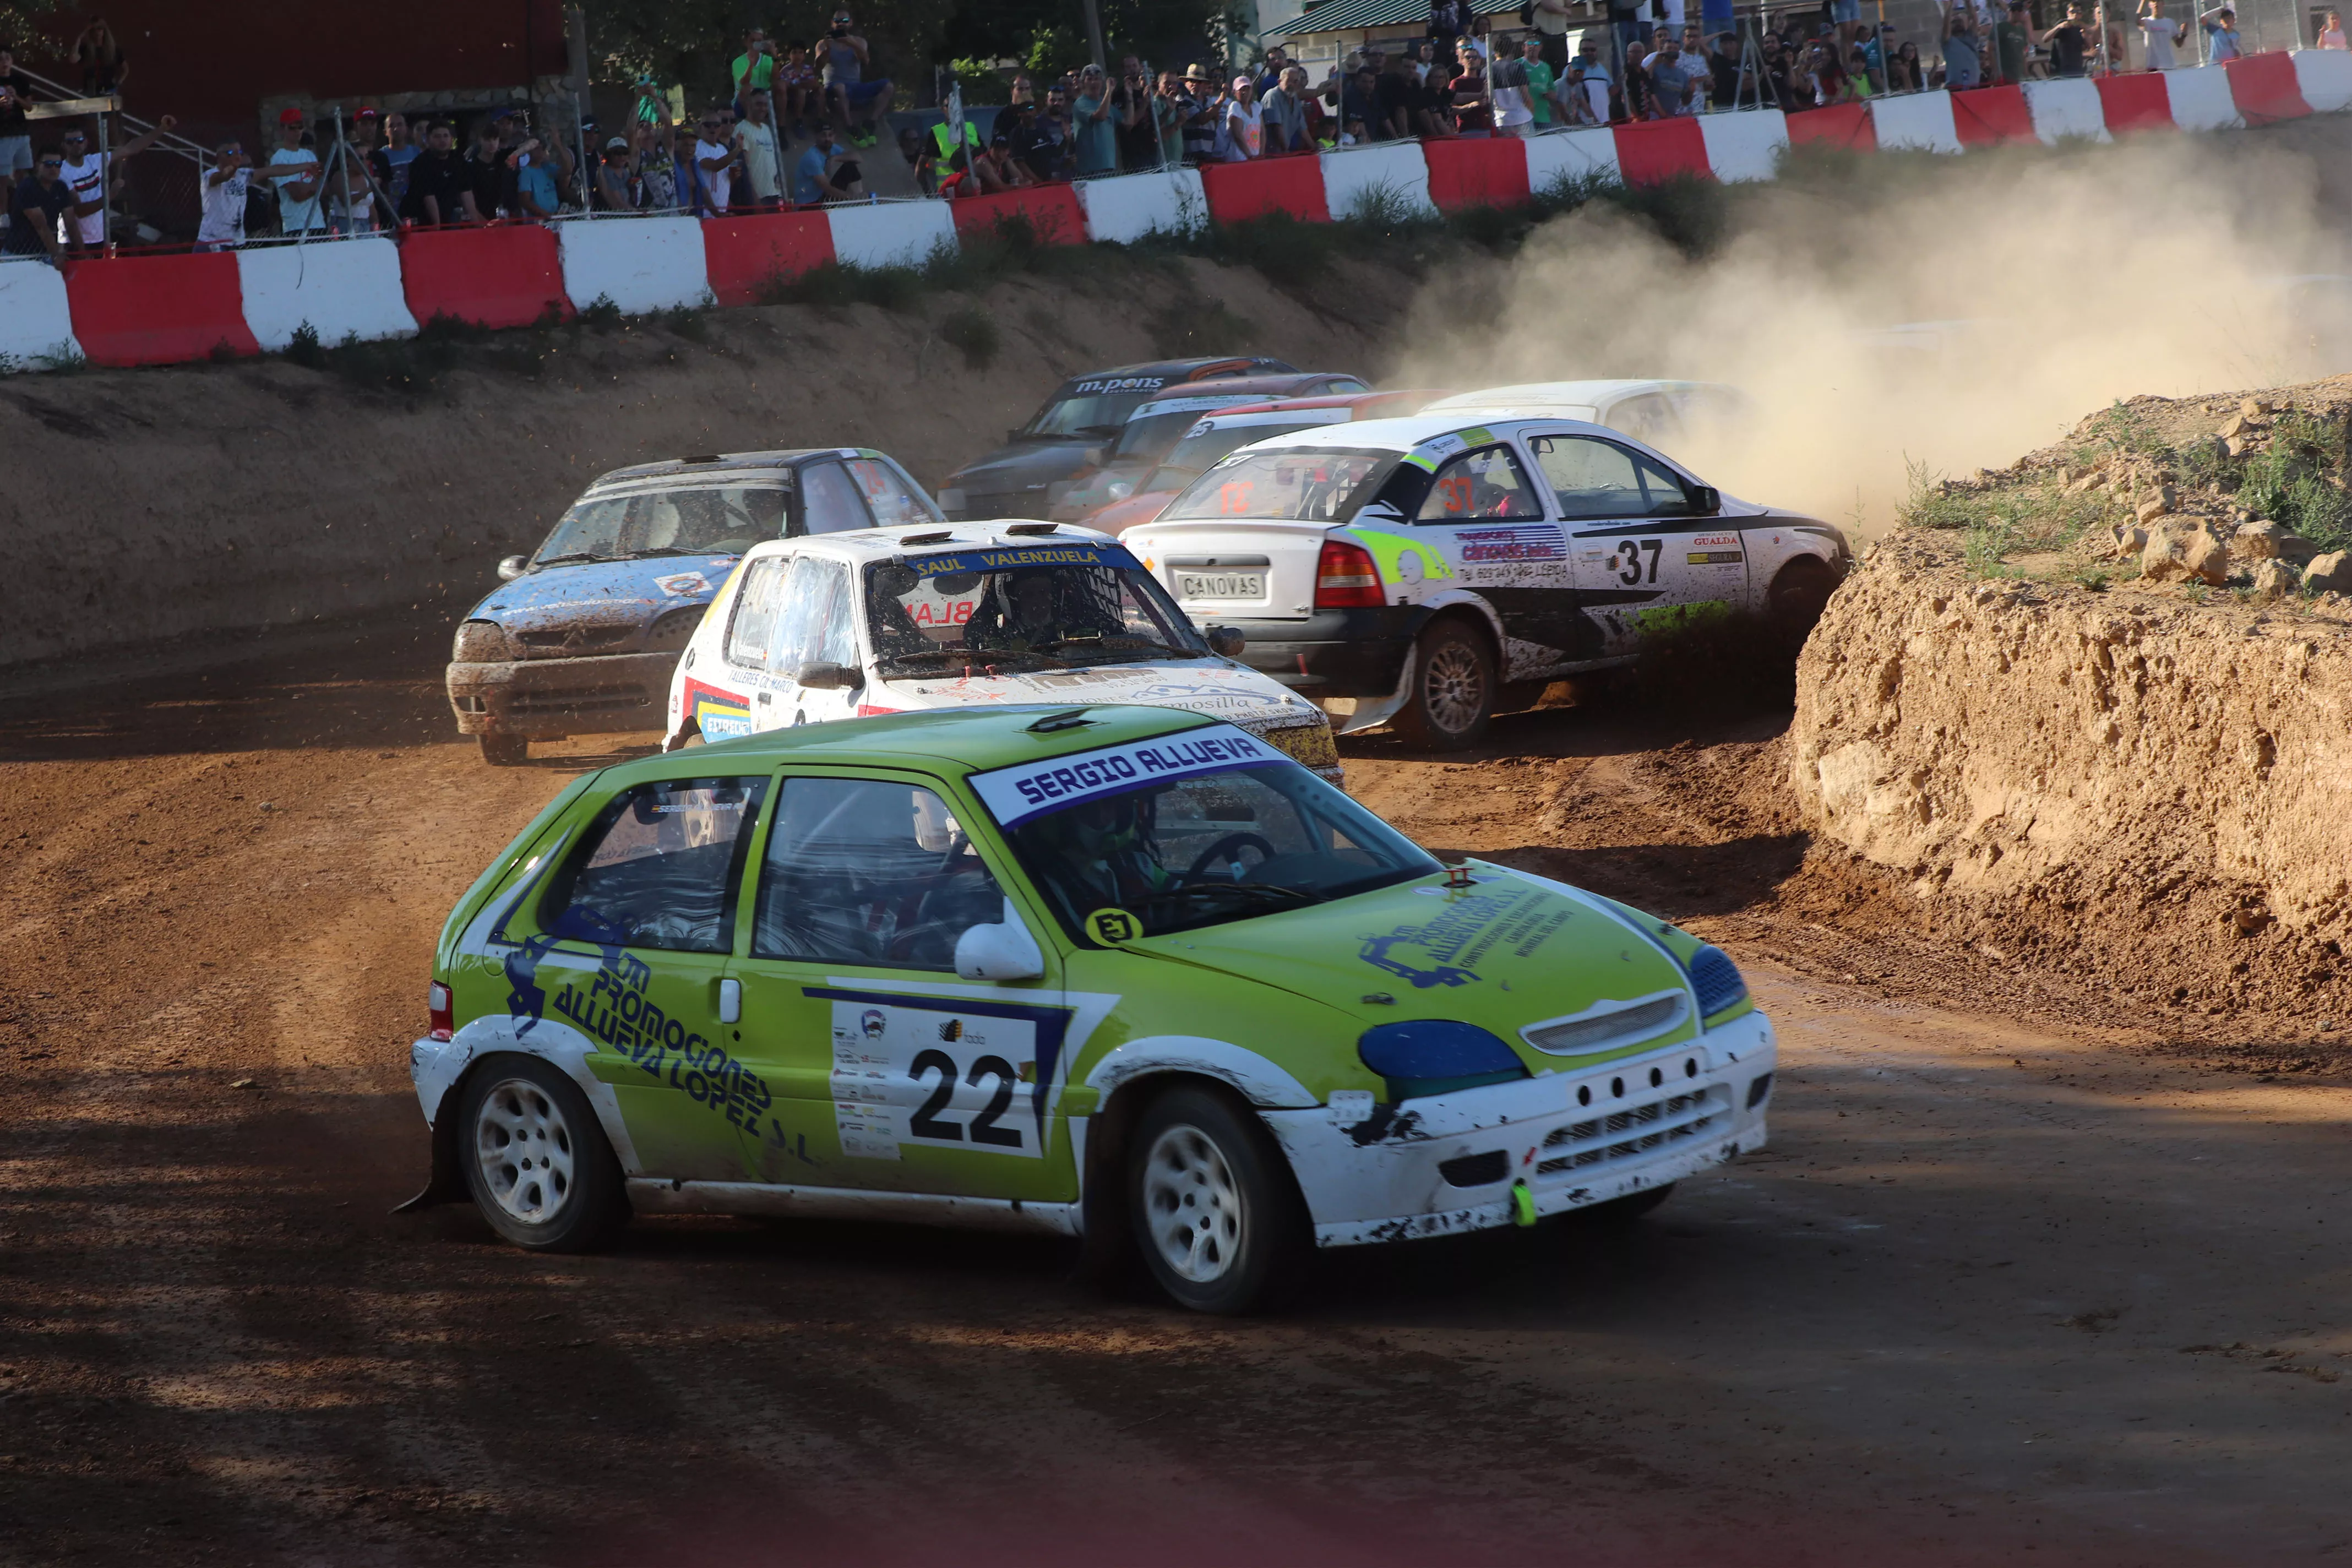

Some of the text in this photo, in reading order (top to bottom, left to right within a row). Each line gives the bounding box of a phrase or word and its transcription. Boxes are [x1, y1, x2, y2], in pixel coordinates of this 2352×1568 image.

[1076, 377, 1164, 394] m.pons
[1185, 422, 1212, 438] 25
[1211, 454, 1256, 470] 37
[1439, 477, 1474, 512] 37
[1694, 537, 1738, 545] GUALDA
[916, 551, 1101, 576] SAUL VALENZUELA
[1618, 539, 1663, 585] 37
[1709, 553, 1733, 562] SEGURA
[1184, 578, 1259, 595] CANOVAS
[727, 669, 794, 693] TALLERES GIL MARCO
[1235, 709, 1266, 720] PHOTO
[1268, 707, 1297, 715] SHOW
[707, 717, 750, 737] ESTRECHO
[1015, 738, 1263, 805] SERGIO ALLUEVA
[590, 968, 772, 1109] PROMOCIONES
[552, 983, 665, 1079] ALLUEVA
[669, 1059, 764, 1137] LOPEZ
[907, 1048, 1023, 1148] 22
